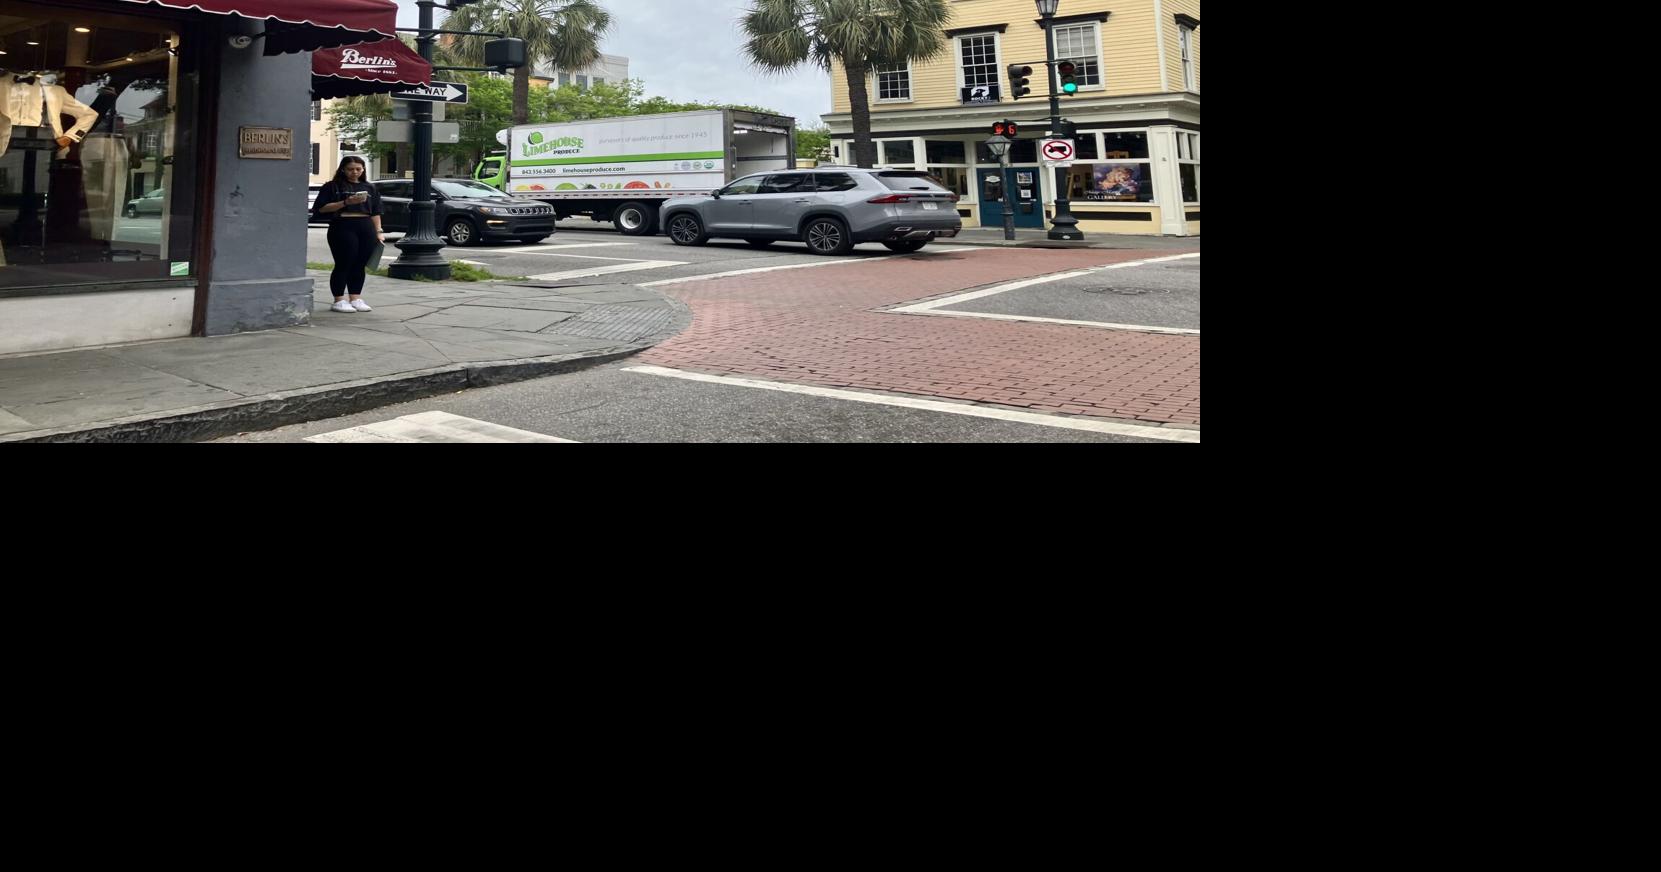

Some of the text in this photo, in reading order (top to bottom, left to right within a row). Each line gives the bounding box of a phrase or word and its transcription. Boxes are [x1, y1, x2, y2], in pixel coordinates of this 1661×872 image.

[340, 49, 396, 66] Berlin's
[424, 87, 447, 97] WAY
[1008, 126, 1015, 135] 6
[522, 136, 584, 157] LIMEHOUSE
